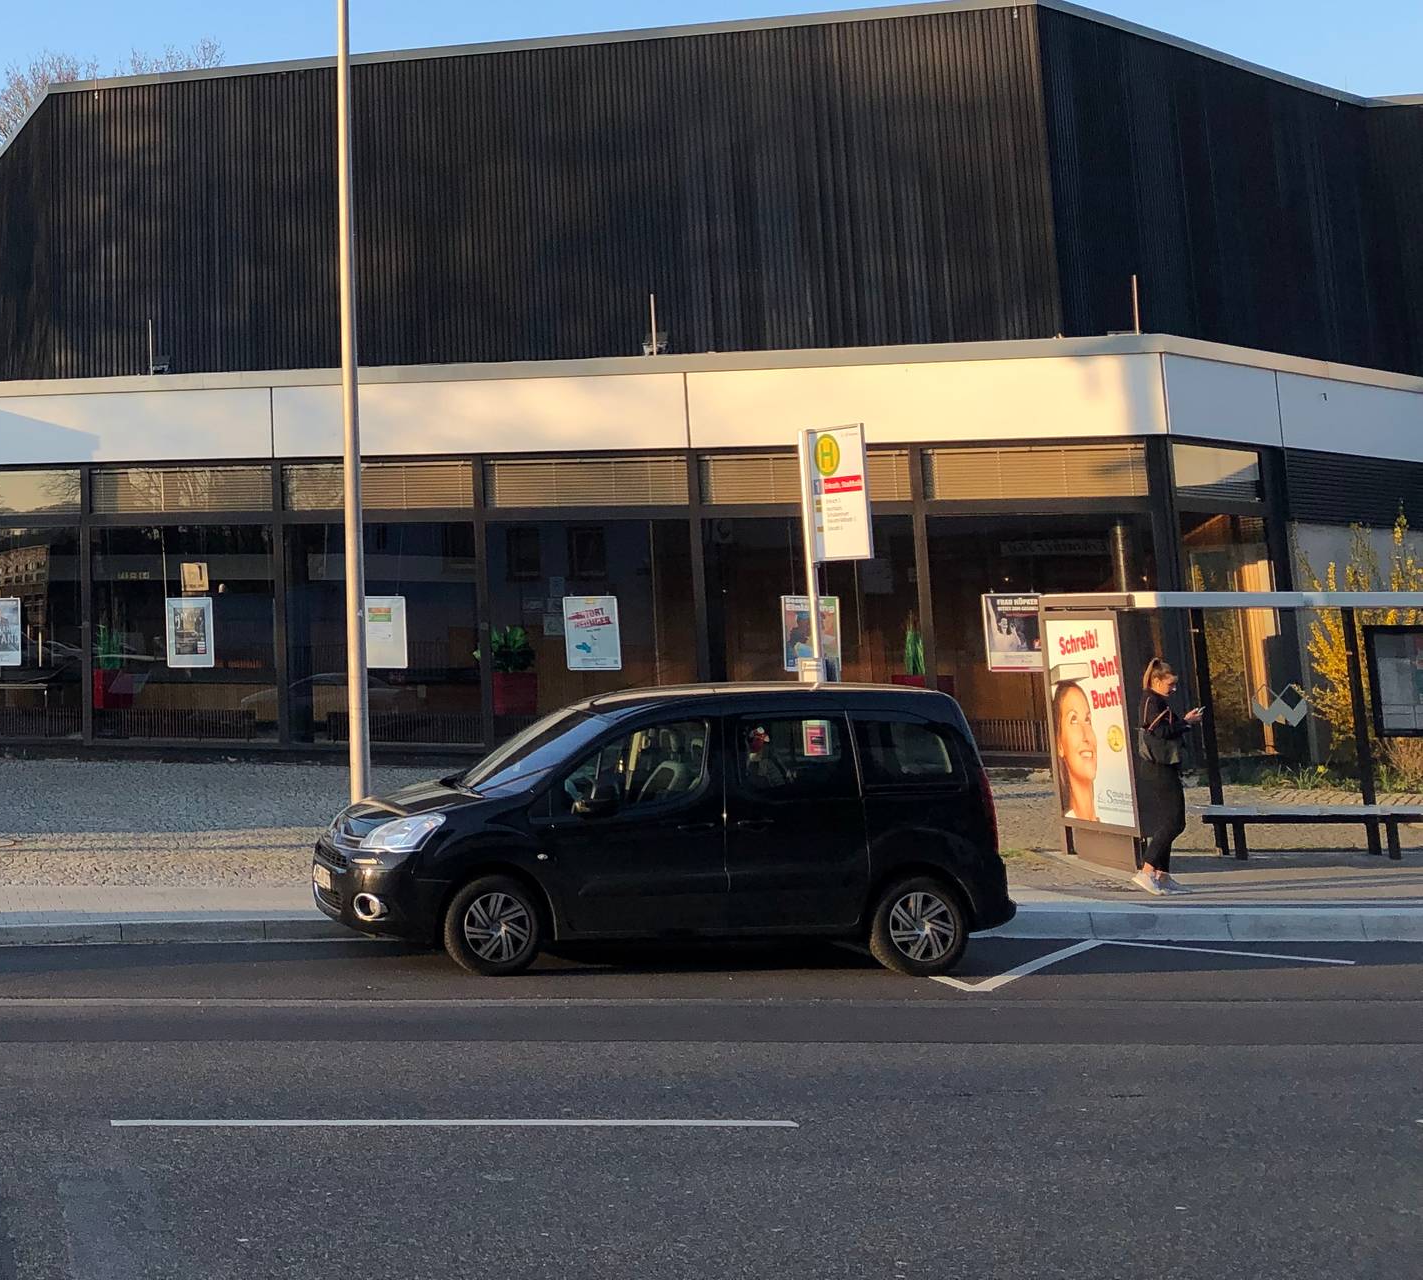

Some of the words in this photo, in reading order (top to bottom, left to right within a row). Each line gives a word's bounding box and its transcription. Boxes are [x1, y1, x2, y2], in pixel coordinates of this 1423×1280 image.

[820, 442, 834, 468] H
[1059, 629, 1099, 656] Schreib!
[1090, 655, 1120, 679] Dein!
[1091, 685, 1123, 709] Buch!
